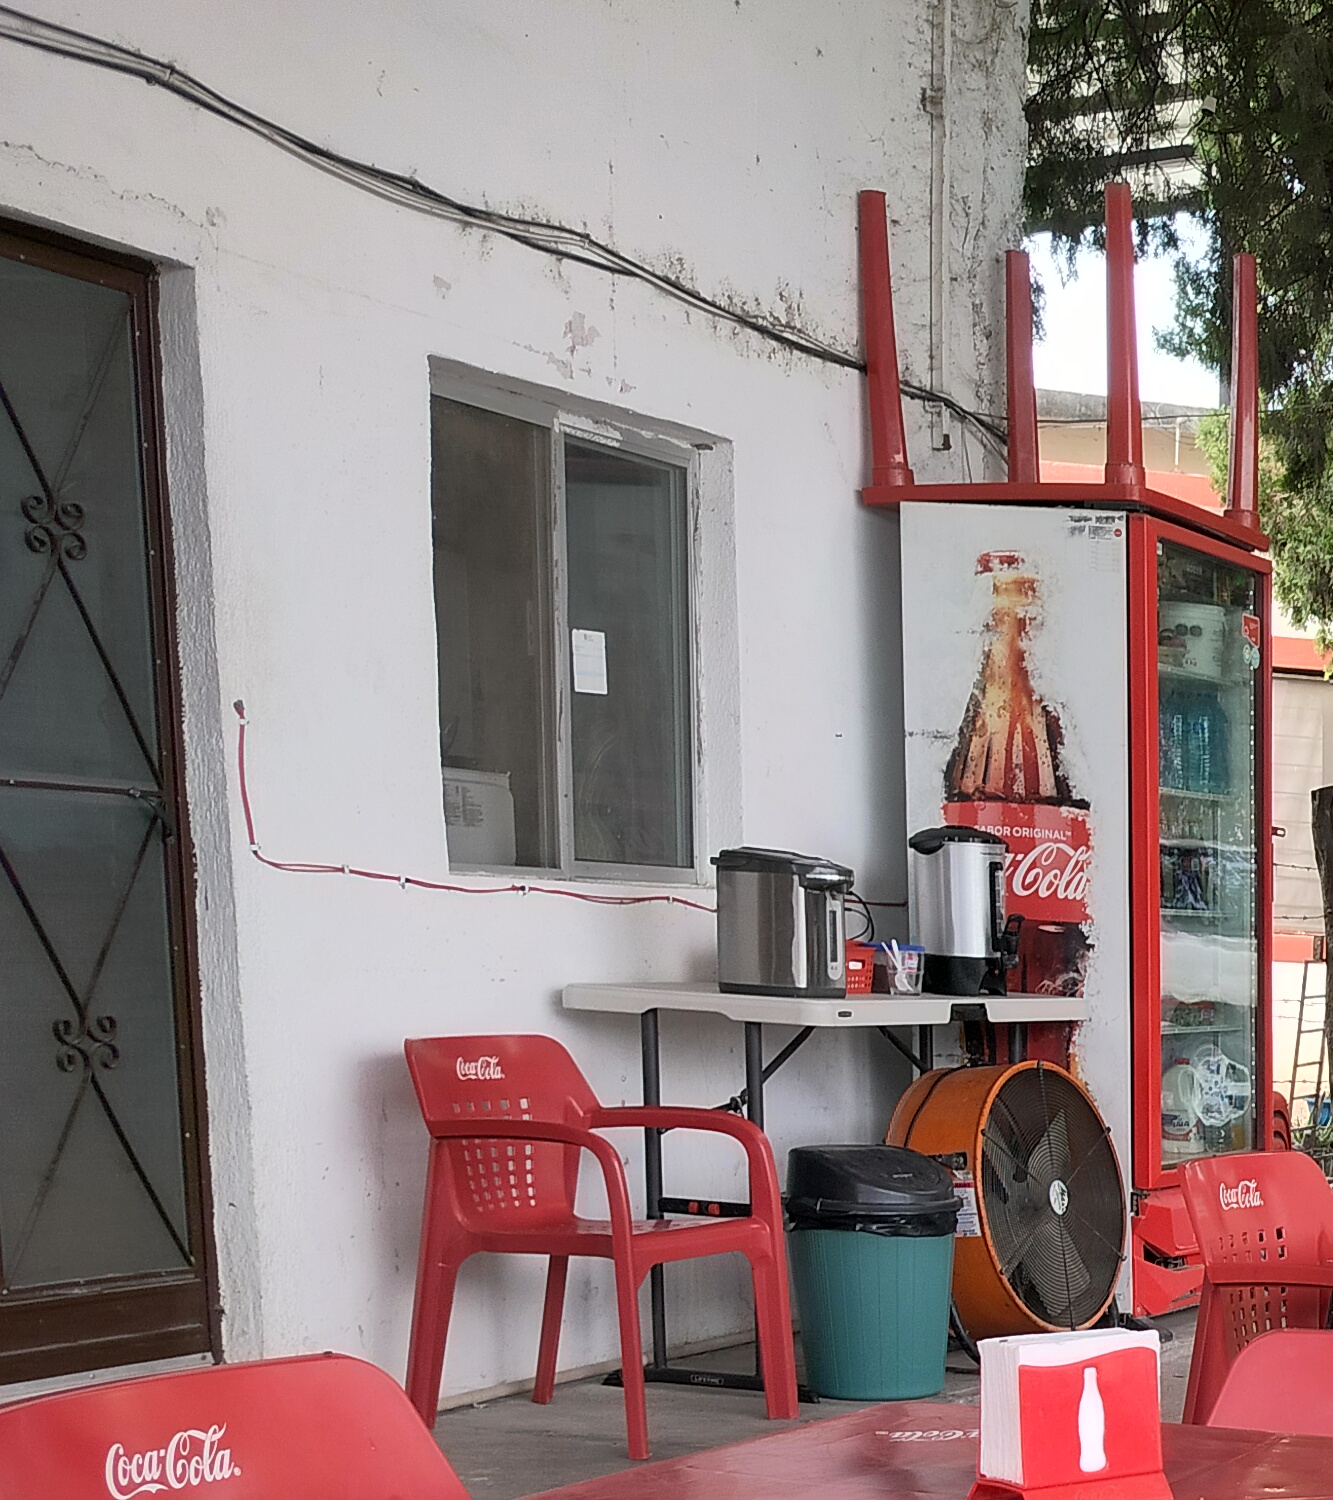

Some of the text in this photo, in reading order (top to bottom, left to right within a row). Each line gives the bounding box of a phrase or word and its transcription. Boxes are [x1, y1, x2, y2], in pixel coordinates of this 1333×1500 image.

[1012, 826, 1067, 840] ORIGINAL
[1004, 842, 1091, 900] -Cola
[456, 1056, 505, 1080] Coca-Cola
[1219, 1179, 1263, 1209] Coca-Cola
[105, 1421, 242, 1500] Coca-Cola
